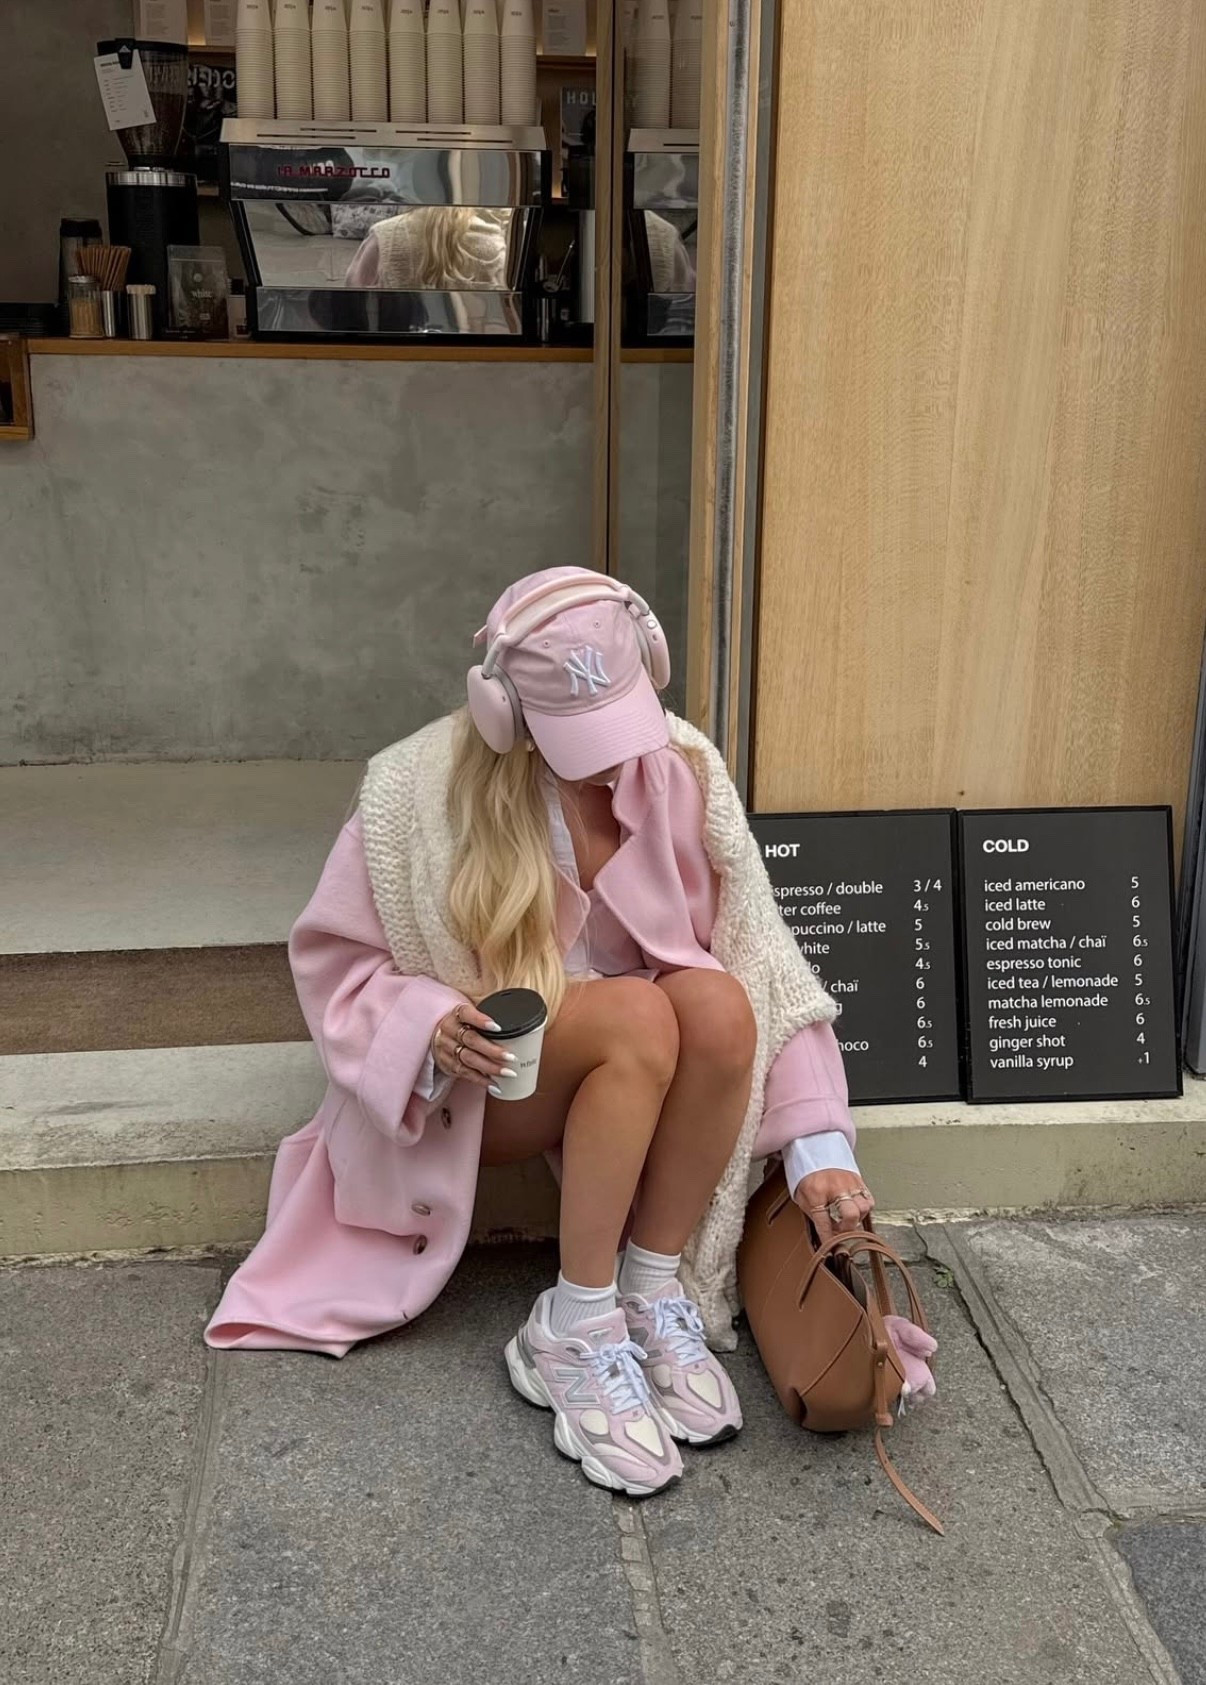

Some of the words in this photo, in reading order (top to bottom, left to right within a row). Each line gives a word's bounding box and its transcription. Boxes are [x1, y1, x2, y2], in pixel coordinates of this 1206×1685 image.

[765, 844, 800, 858] HOT
[983, 839, 1029, 853] COLD
[774, 885, 825, 899] spresso
[827, 883, 832, 895] /
[836, 881, 883, 895] double
[914, 880, 921, 892] 3
[925, 879, 930, 892] /
[933, 880, 942, 891] 4
[985, 879, 1011, 892] iced
[1015, 878, 1085, 891] americano
[1132, 877, 1139, 888] 5
[779, 904, 797, 916] ter
[800, 902, 841, 915] coffee
[985, 898, 1012, 911] iced
[1016, 898, 1045, 910] latte
[1132, 896, 1140, 908] 6
[792, 922, 845, 936] puccino
[847, 921, 853, 934] /
[857, 920, 886, 933] latte
[915, 919, 922, 931] 5
[986, 918, 1013, 931] cold
[1018, 918, 1051, 930] brew
[1133, 915, 1140, 927] 5
[987, 937, 1013, 950] iced
[1018, 936, 1066, 949] matcha
[1070, 936, 1075, 948] /
[1079, 935, 1107, 948] chaï
[986, 959, 1045, 973] espresso
[1048, 956, 1081, 968] tonic
[1134, 954, 1142, 966] 6
[831, 980, 858, 993] chaï
[916, 977, 924, 989] 6
[988, 976, 1015, 989] iced
[1018, 977, 1040, 989] tea
[1043, 976, 1048, 988] /
[1052, 974, 1118, 987] lemonade
[1135, 974, 1142, 985] 5
[917, 997, 925, 1009] 6
[988, 996, 1037, 1009] matcha
[1041, 993, 1108, 1008] lemonade
[989, 1015, 1021, 1028] fresh
[1024, 1016, 1056, 1031] juice
[1136, 1013, 1144, 1024] 6
[990, 1036, 1033, 1052] ginger
[1037, 1034, 1065, 1047] shot
[1137, 1033, 1145, 1044] 4
[919, 1056, 927, 1067] 4
[990, 1054, 1033, 1069] vanilla
[1037, 1057, 1073, 1070] syrup
